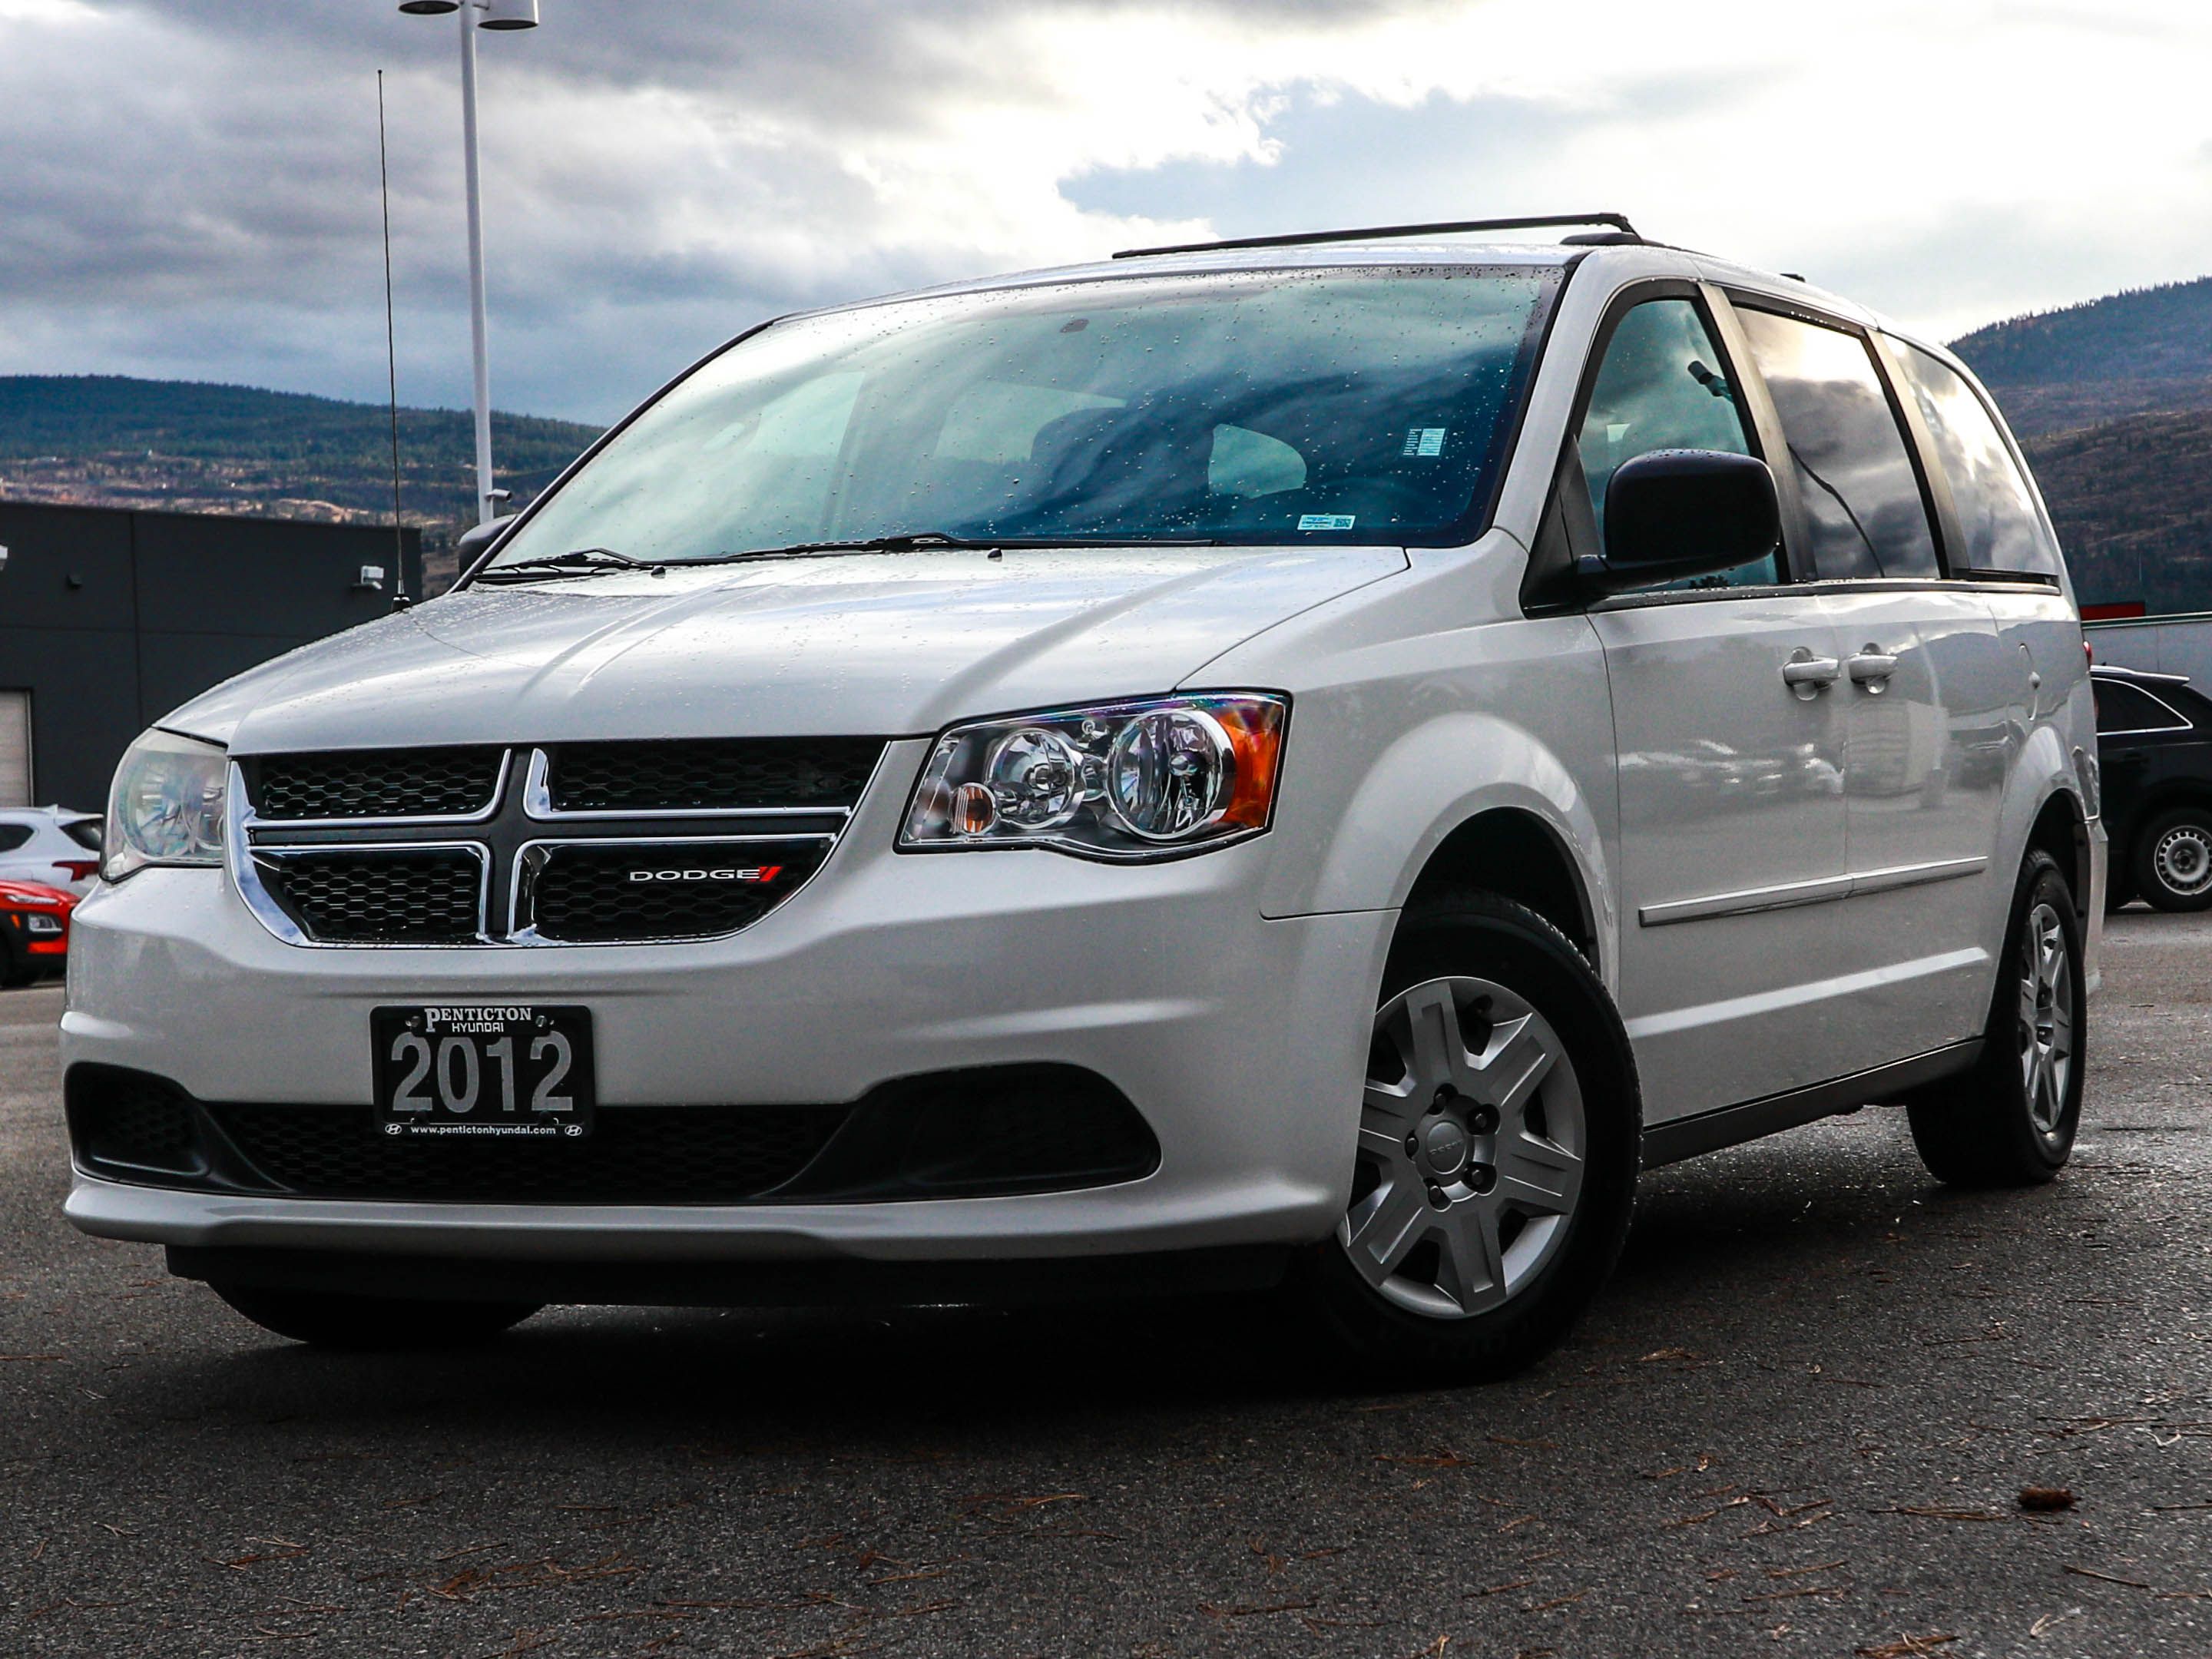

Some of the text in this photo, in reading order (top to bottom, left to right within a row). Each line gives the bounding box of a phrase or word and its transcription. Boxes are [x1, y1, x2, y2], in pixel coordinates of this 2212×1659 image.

[629, 869, 760, 881] DODGE
[424, 1008, 532, 1032] PENTICTON
[452, 1022, 504, 1032] HYUNDAI
[391, 1031, 573, 1113] 2012
[411, 1125, 556, 1135] www.pentictonhyundai.com
